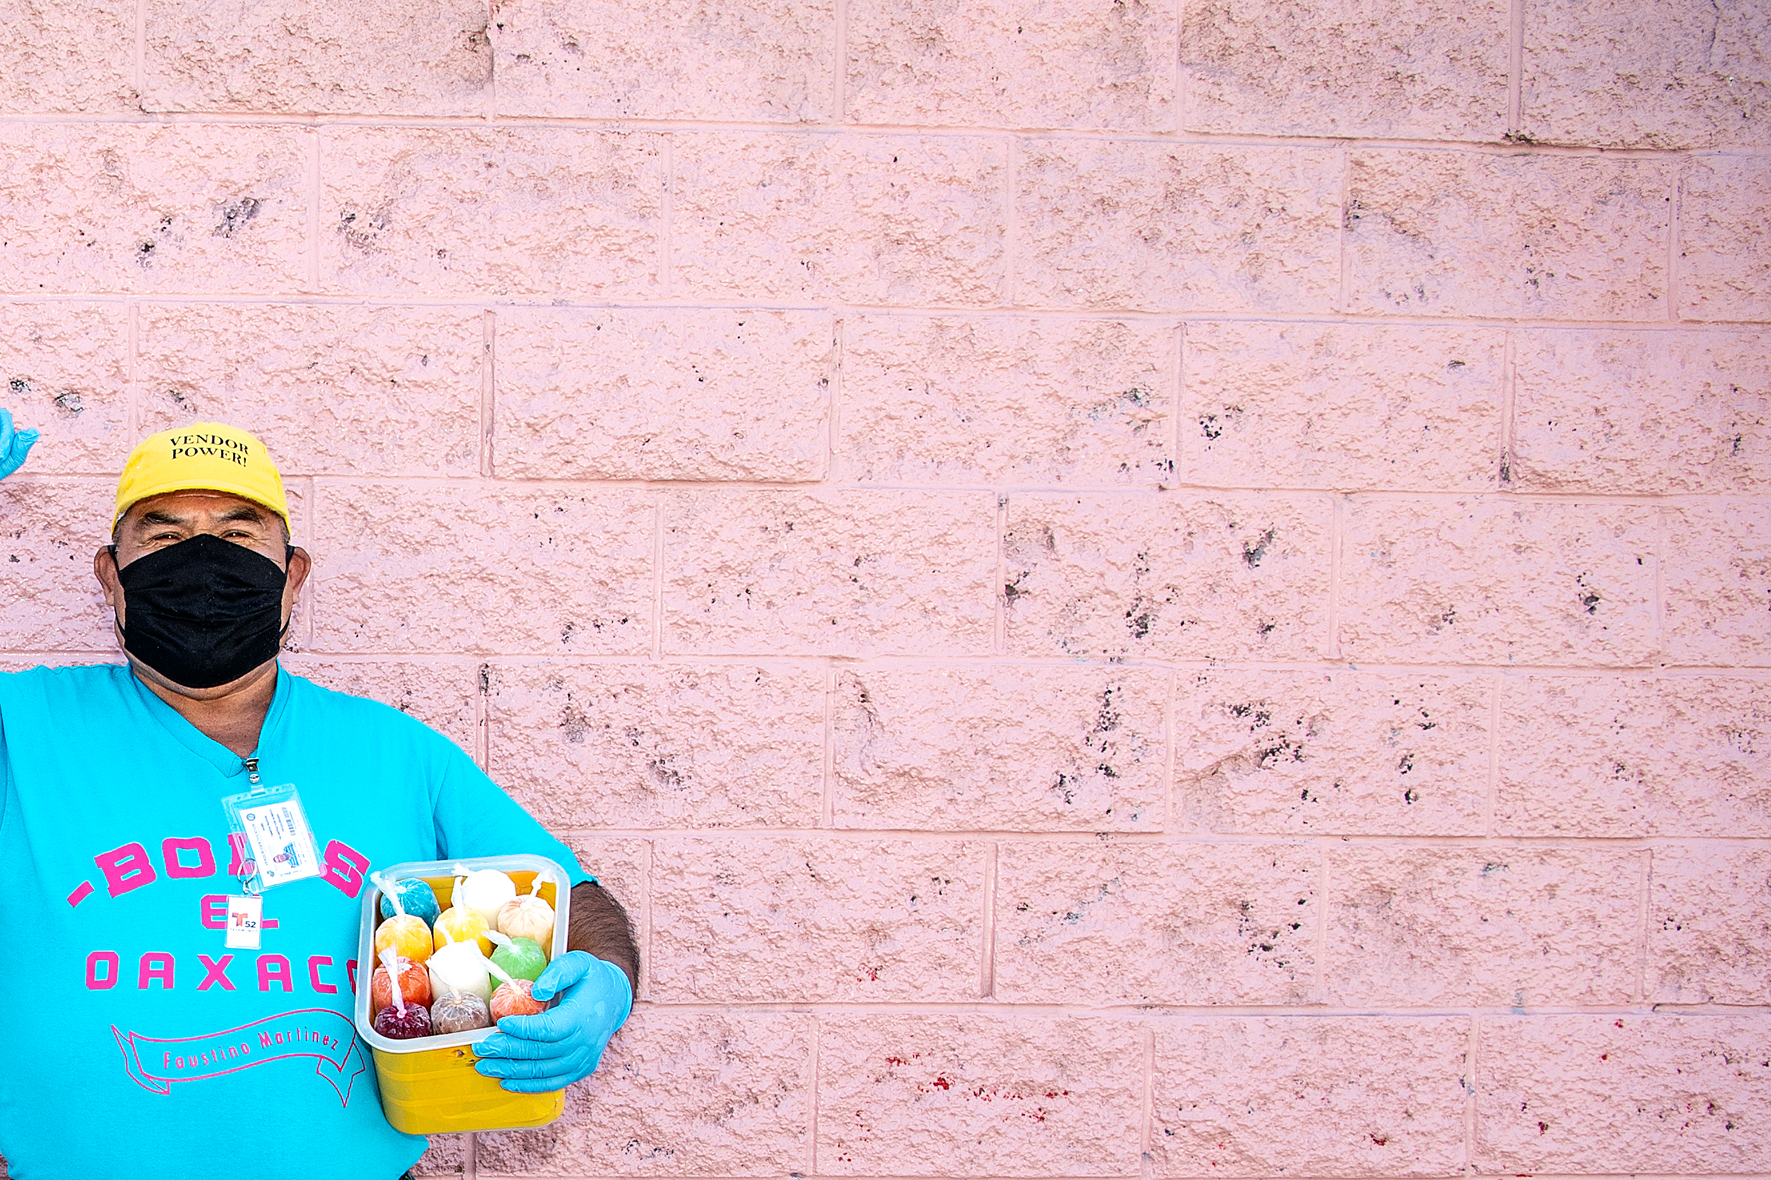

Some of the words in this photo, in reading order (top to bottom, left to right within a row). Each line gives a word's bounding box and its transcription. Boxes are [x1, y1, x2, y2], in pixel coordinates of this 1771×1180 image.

[170, 434, 249, 456] VENDOR
[172, 447, 246, 467] POWER!
[85, 951, 358, 996] OAXAC
[164, 1042, 250, 1069] Faustino
